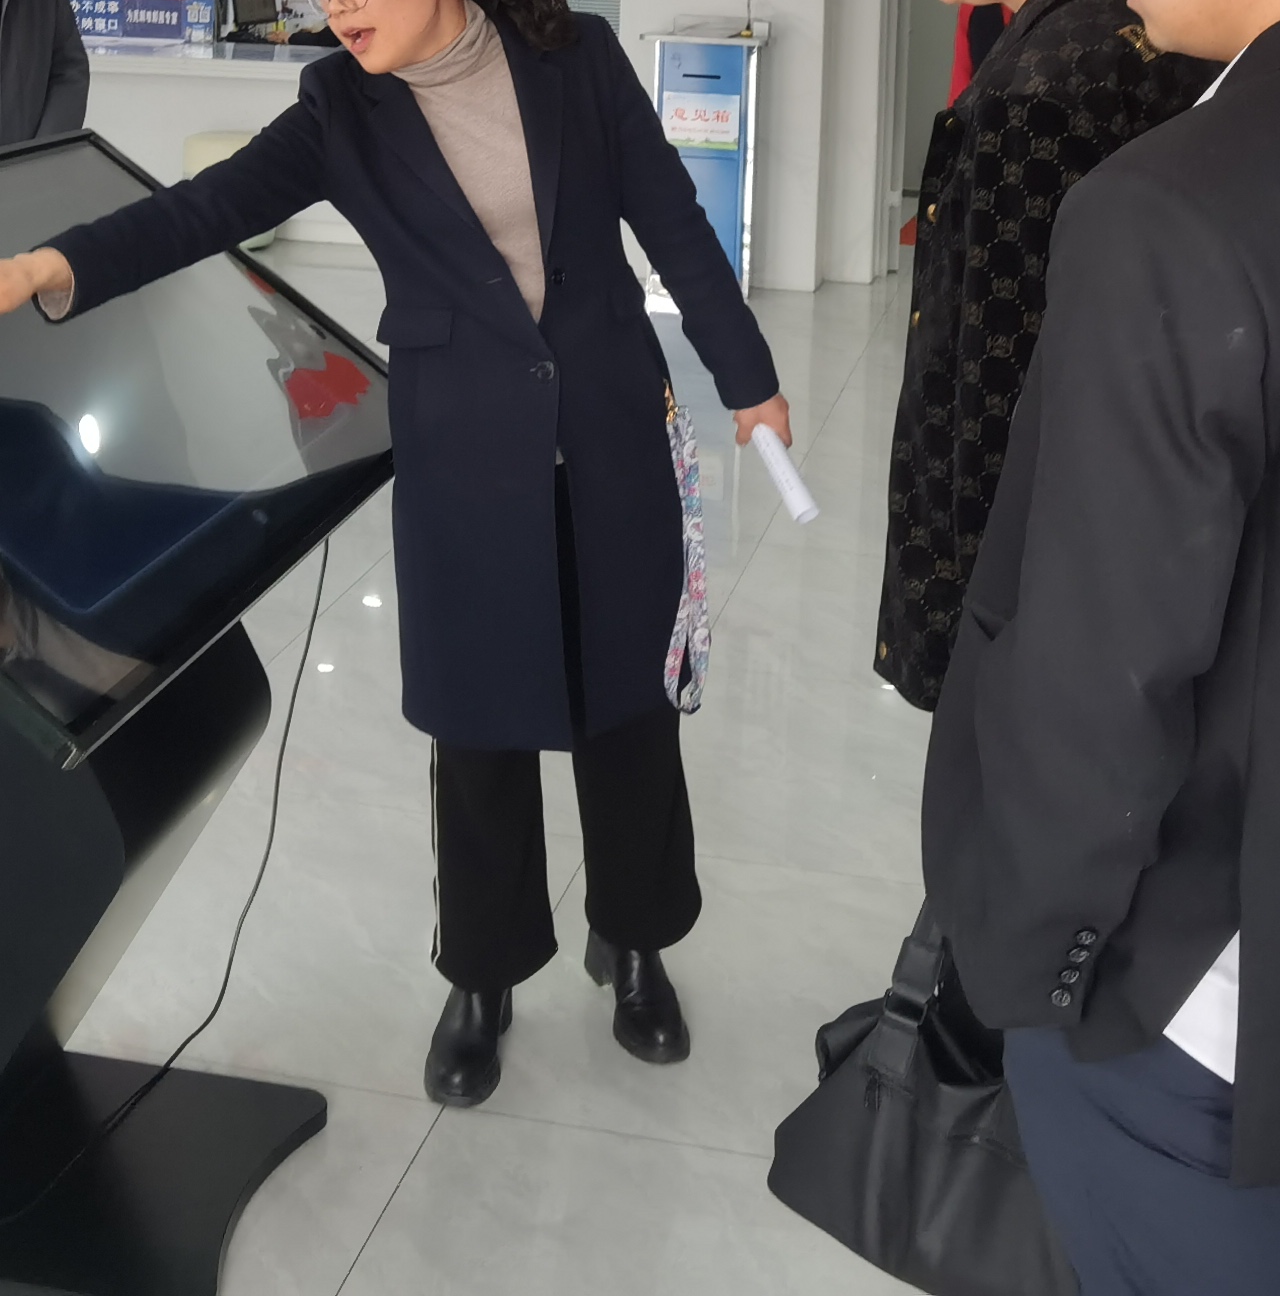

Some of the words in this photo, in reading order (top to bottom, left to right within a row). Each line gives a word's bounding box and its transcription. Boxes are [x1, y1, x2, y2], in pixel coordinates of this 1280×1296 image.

[75, 17, 119, 32] 映窗口
[670, 107, 731, 123] 意见箱
